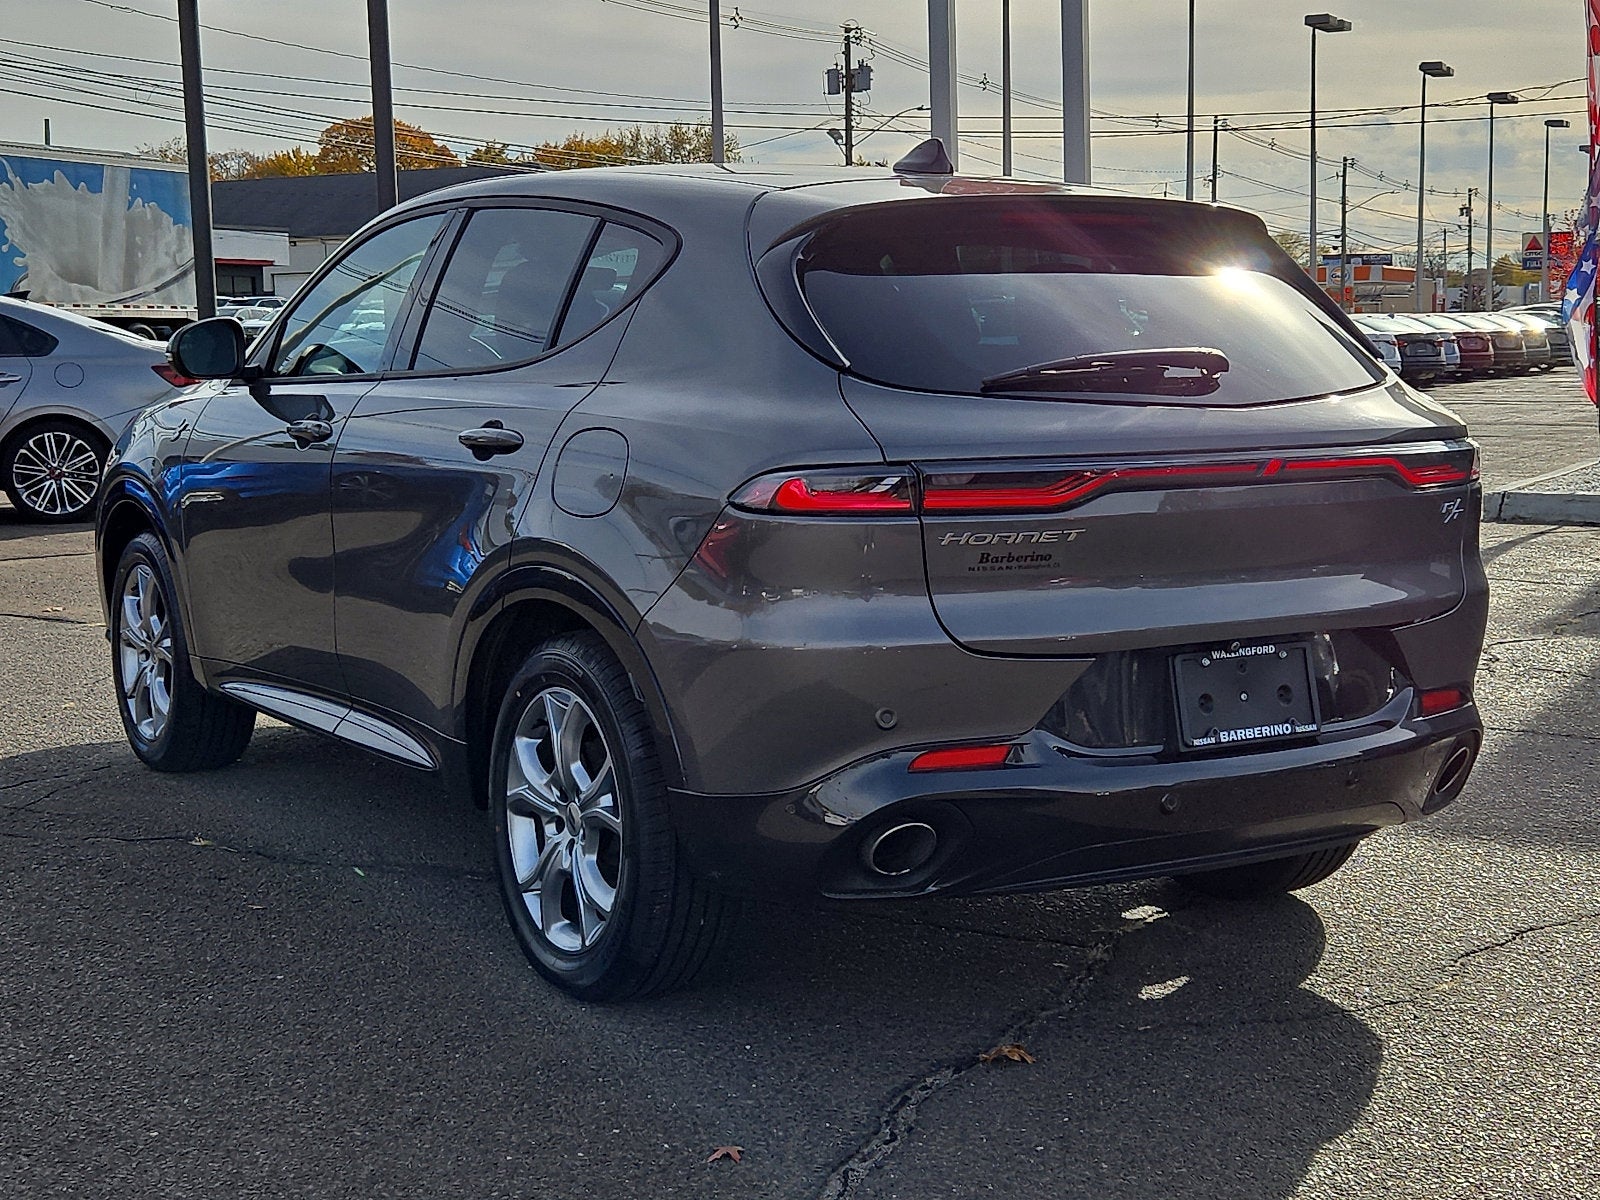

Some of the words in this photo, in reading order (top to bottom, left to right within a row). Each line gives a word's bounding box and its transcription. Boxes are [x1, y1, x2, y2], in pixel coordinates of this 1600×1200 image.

[938, 528, 1087, 546] HORNET
[978, 551, 1053, 564] Barberino
[1193, 736, 1216, 747] NISSAN
[1219, 723, 1292, 743] BARBERINO
[1295, 723, 1318, 733] NISSAN
